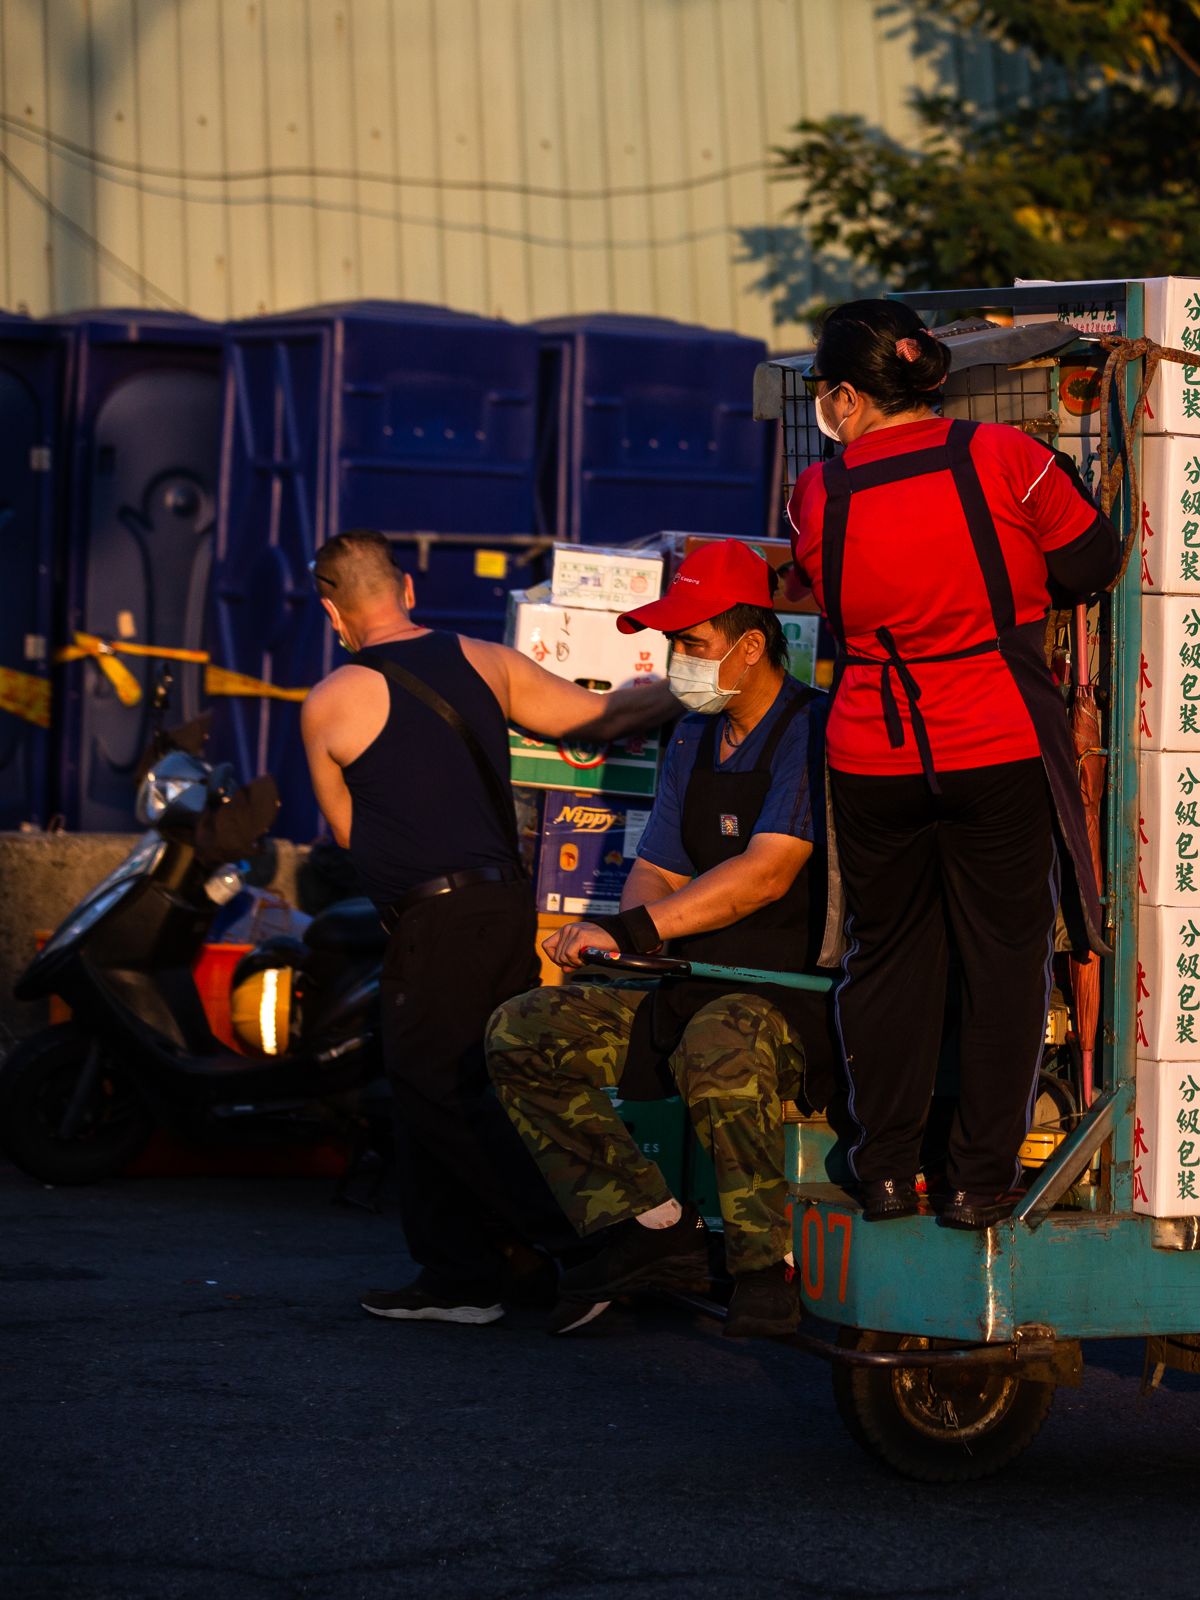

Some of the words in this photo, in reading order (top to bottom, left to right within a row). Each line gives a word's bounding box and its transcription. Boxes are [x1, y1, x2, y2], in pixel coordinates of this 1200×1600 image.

[1175, 767, 1200, 892] 分級包裝
[784, 1203, 851, 1304] 07
